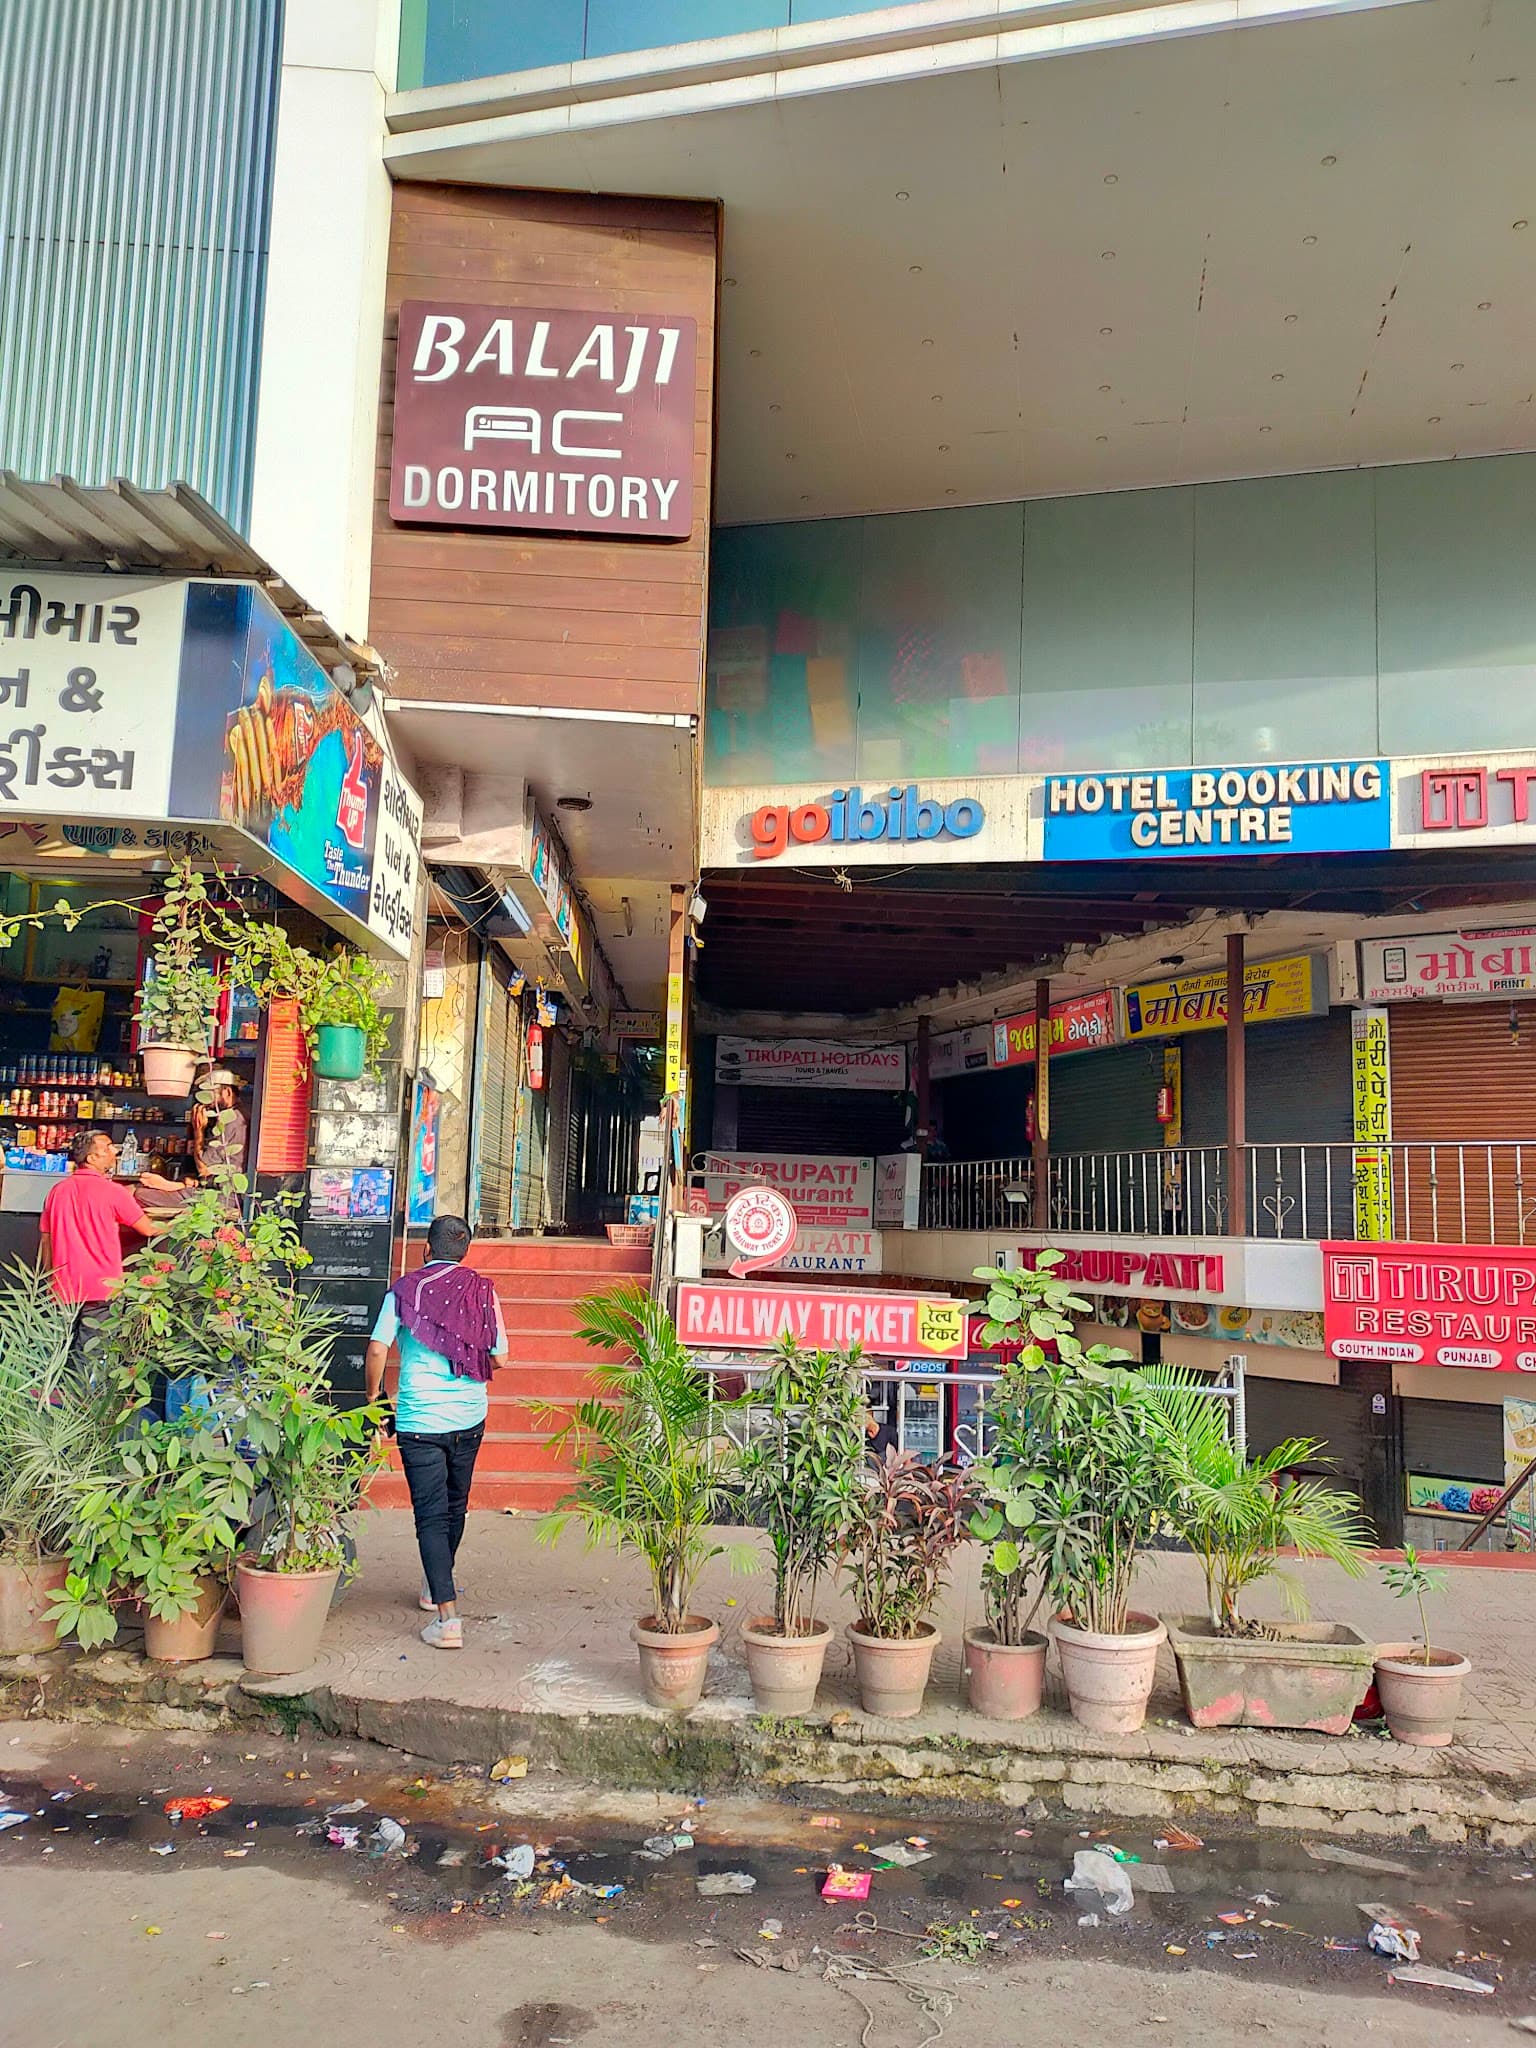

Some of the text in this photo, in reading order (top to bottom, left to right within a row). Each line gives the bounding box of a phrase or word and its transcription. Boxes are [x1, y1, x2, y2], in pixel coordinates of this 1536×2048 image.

[412, 315, 680, 394] BALAJI
[464, 405, 623, 458] AC
[403, 465, 679, 521] DORMITORY
[58, 667, 104, 713] &
[1049, 764, 1381, 813] HOTEL BOOKING
[751, 784, 985, 858] goibibo
[1131, 806, 1293, 847] CENTRE
[324, 839, 344, 861] Taste
[385, 833, 411, 884] પાન &
[327, 864, 371, 891] Thunder
[745, 1050, 901, 1067] TIRUPATI HOLIDAYS
[732, 1230, 784, 1251] RAILWAY TICKET
[1382, 1262, 1536, 1307] TIRUP
[687, 1294, 913, 1345] RAILWAY TICKET
[921, 1322, 960, 1343] टिकट
[912, 1361, 946, 1374] pepsi
[1338, 1343, 1373, 1356] SOUTH
[1377, 1346, 1415, 1359] INDIAN
[1443, 1351, 1492, 1365] PUNJABI
